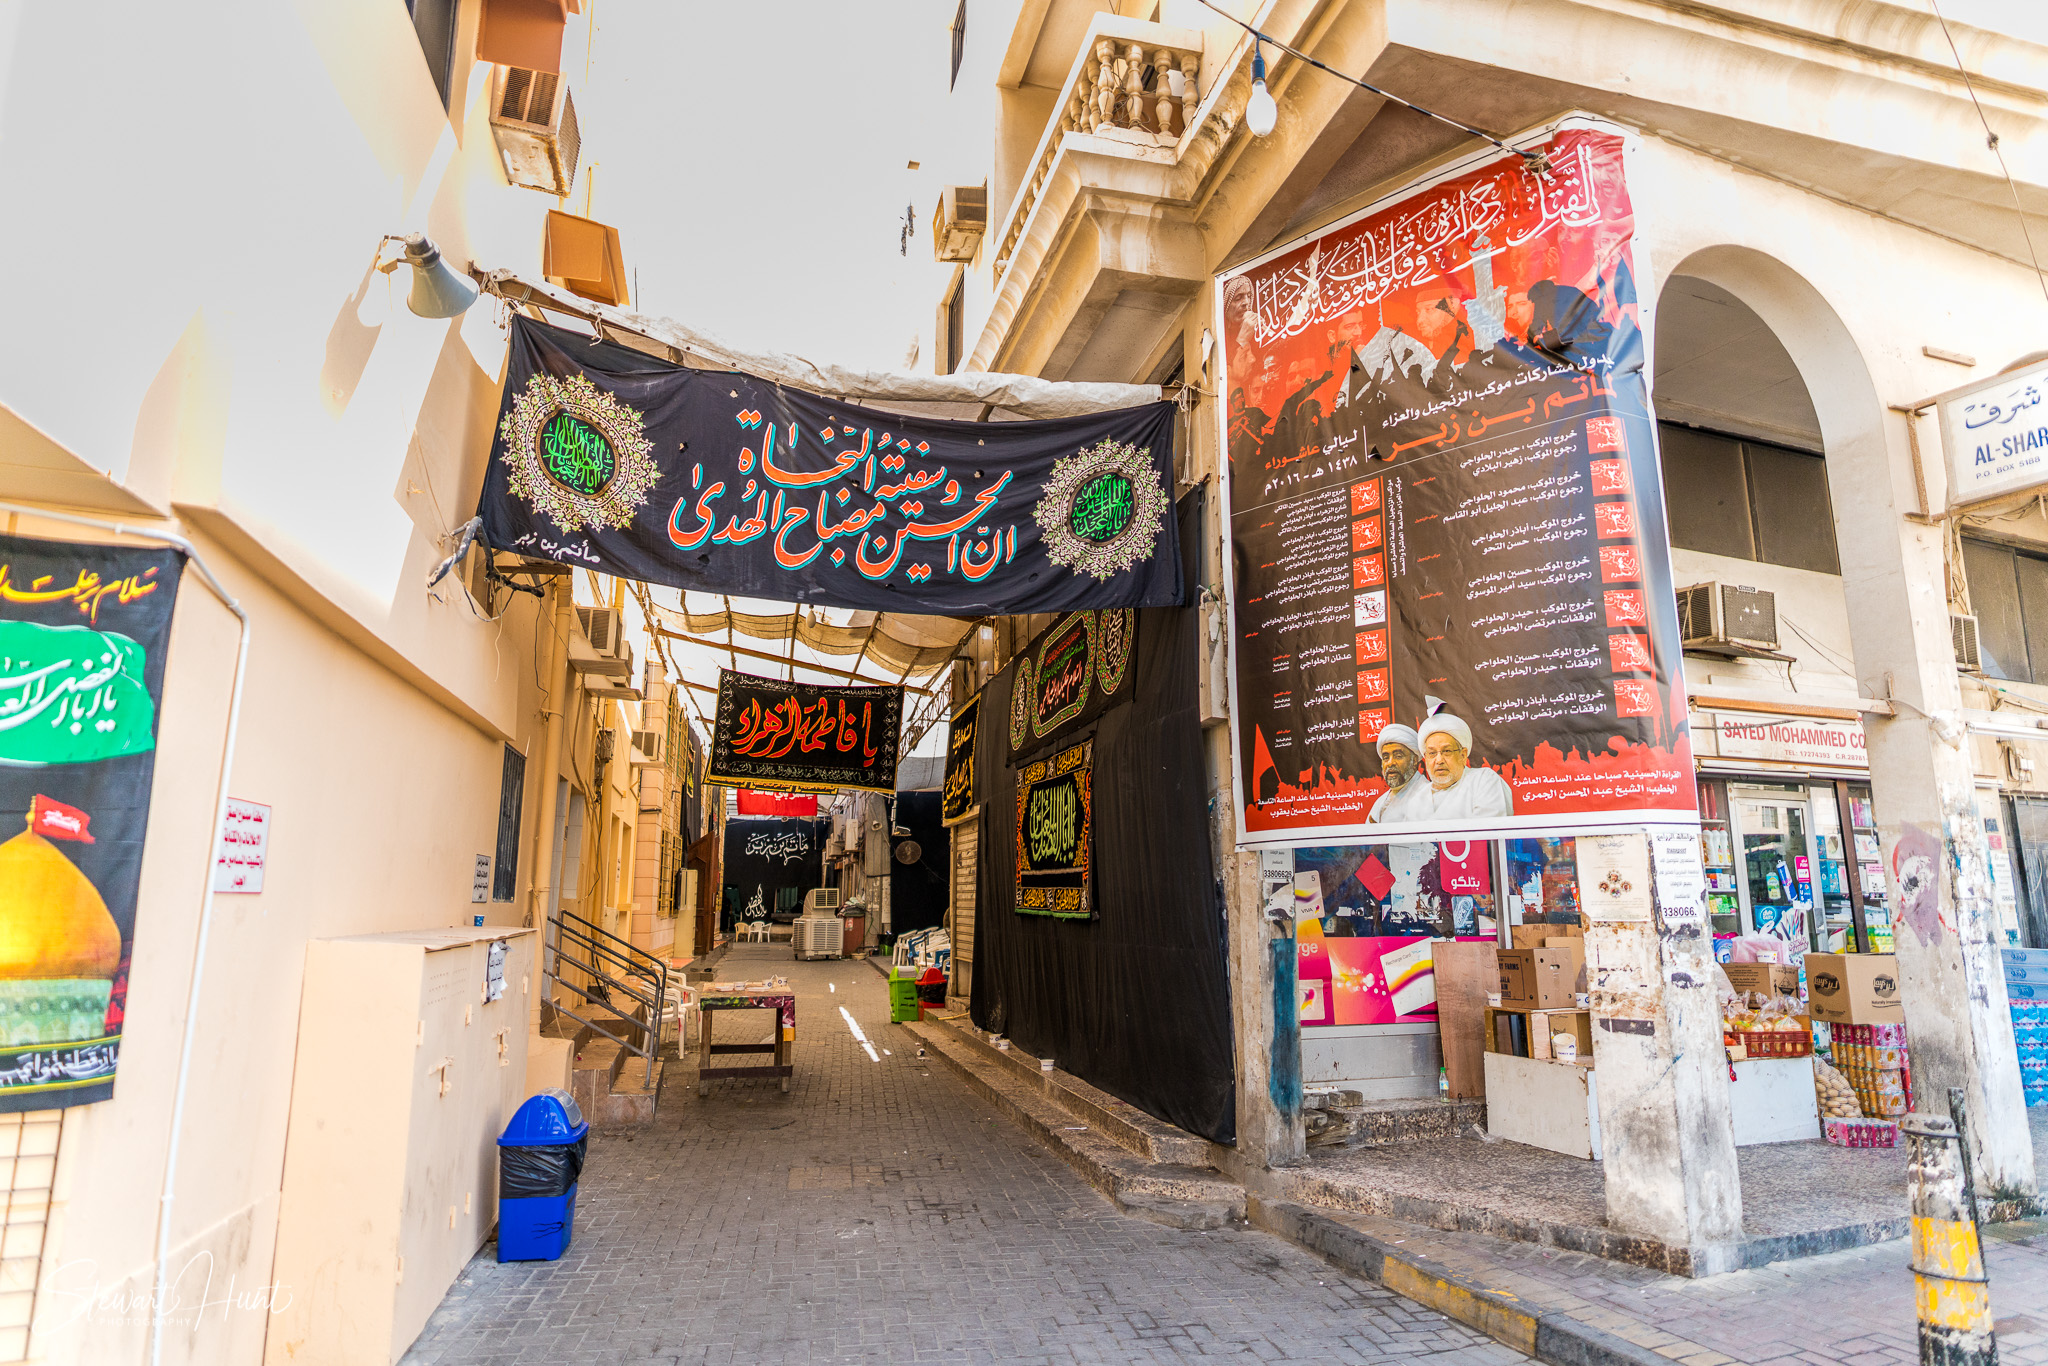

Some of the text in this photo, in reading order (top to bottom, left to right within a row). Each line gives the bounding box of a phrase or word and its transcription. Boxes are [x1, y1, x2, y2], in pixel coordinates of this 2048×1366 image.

[1514, 363, 1574, 386] مشاركات
[1475, 380, 1512, 401] موكب
[1422, 390, 1472, 417] الزنجيل
[1382, 408, 1421, 429] والعزاء
[1467, 396, 1536, 438] بن
[1382, 412, 1460, 462] زبر
[1264, 428, 1358, 471] ليالي عاشوراء
[1328, 455, 1358, 473] ١٤٣٨
[1996, 463, 2015, 474] BOX
[2019, 456, 2041, 467] 5188
[774, 487, 886, 570] مصباح
[730, 695, 802, 758] الزهراء
[797, 696, 857, 753] فاطمة
[861, 701, 878, 767] يا
[1724, 721, 1766, 741] SAYED
[1768, 725, 1847, 748] MOHAMMED
[1512, 775, 1542, 787] العاشرة
[1543, 774, 1572, 785] الساعة
[1573, 774, 1592, 784] عند
[1593, 772, 1622, 782] صباحا
[1295, 794, 1308, 802] عند
[1559, 787, 1591, 800] المحسن
[1593, 787, 1613, 797] عبد
[1615, 784, 1645, 797] الشيخ
[1276, 794, 1295, 804] الساعة
[1269, 808, 1291, 818] يعقوب
[1291, 807, 1310, 815] حسين
[1310, 805, 1331, 815] الشيخ
[1450, 876, 1481, 890] بتلكو
[1385, 952, 1412, 966] Recharge Card
